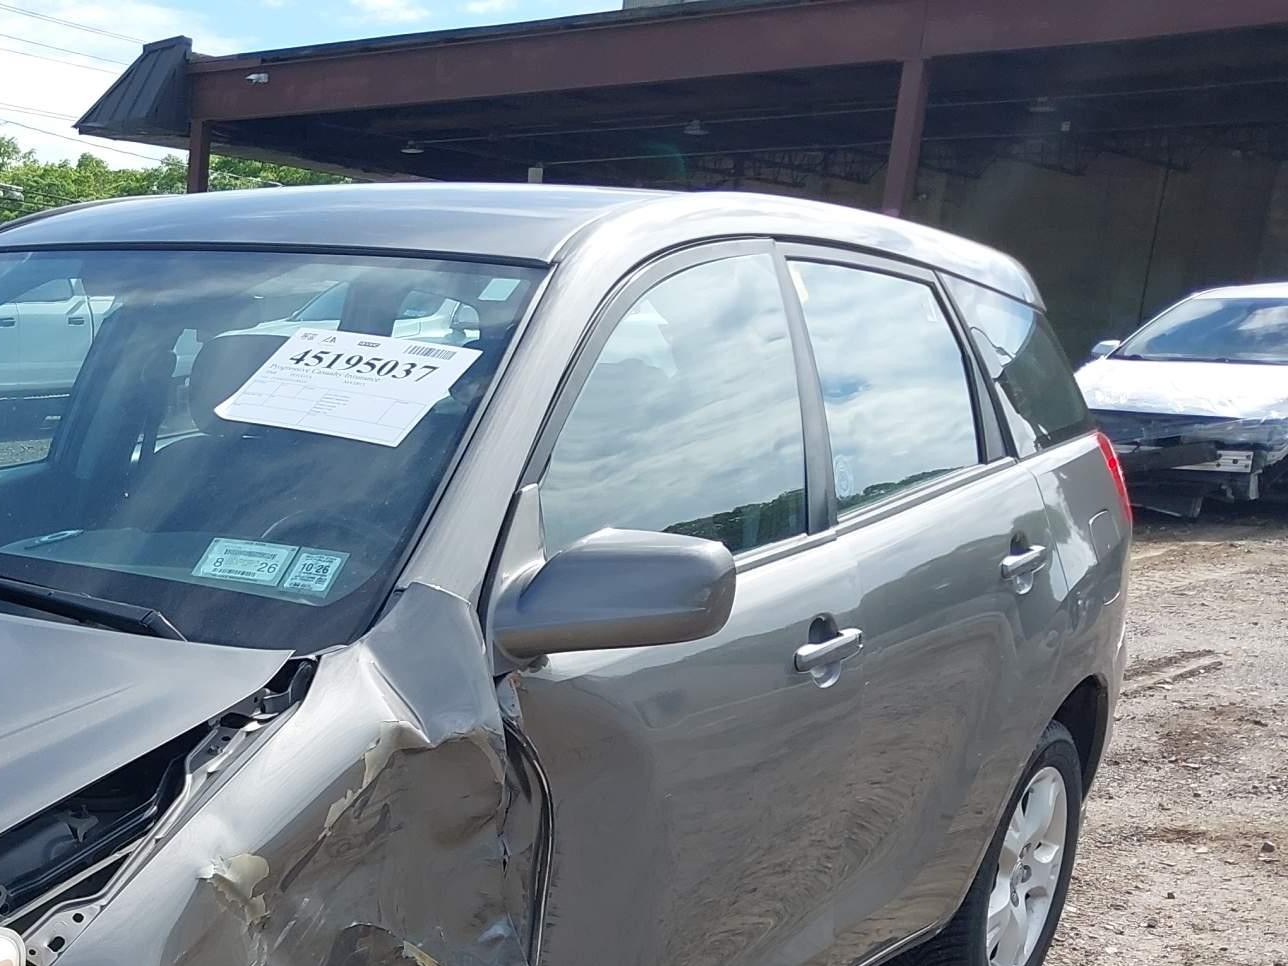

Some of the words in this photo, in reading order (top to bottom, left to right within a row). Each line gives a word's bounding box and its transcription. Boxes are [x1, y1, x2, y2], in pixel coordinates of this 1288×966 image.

[289, 348, 440, 383] 45195037
[213, 557, 224, 568] 8
[257, 562, 279, 574] 26
[301, 562, 314, 572] 10
[315, 564, 330, 575] 26
